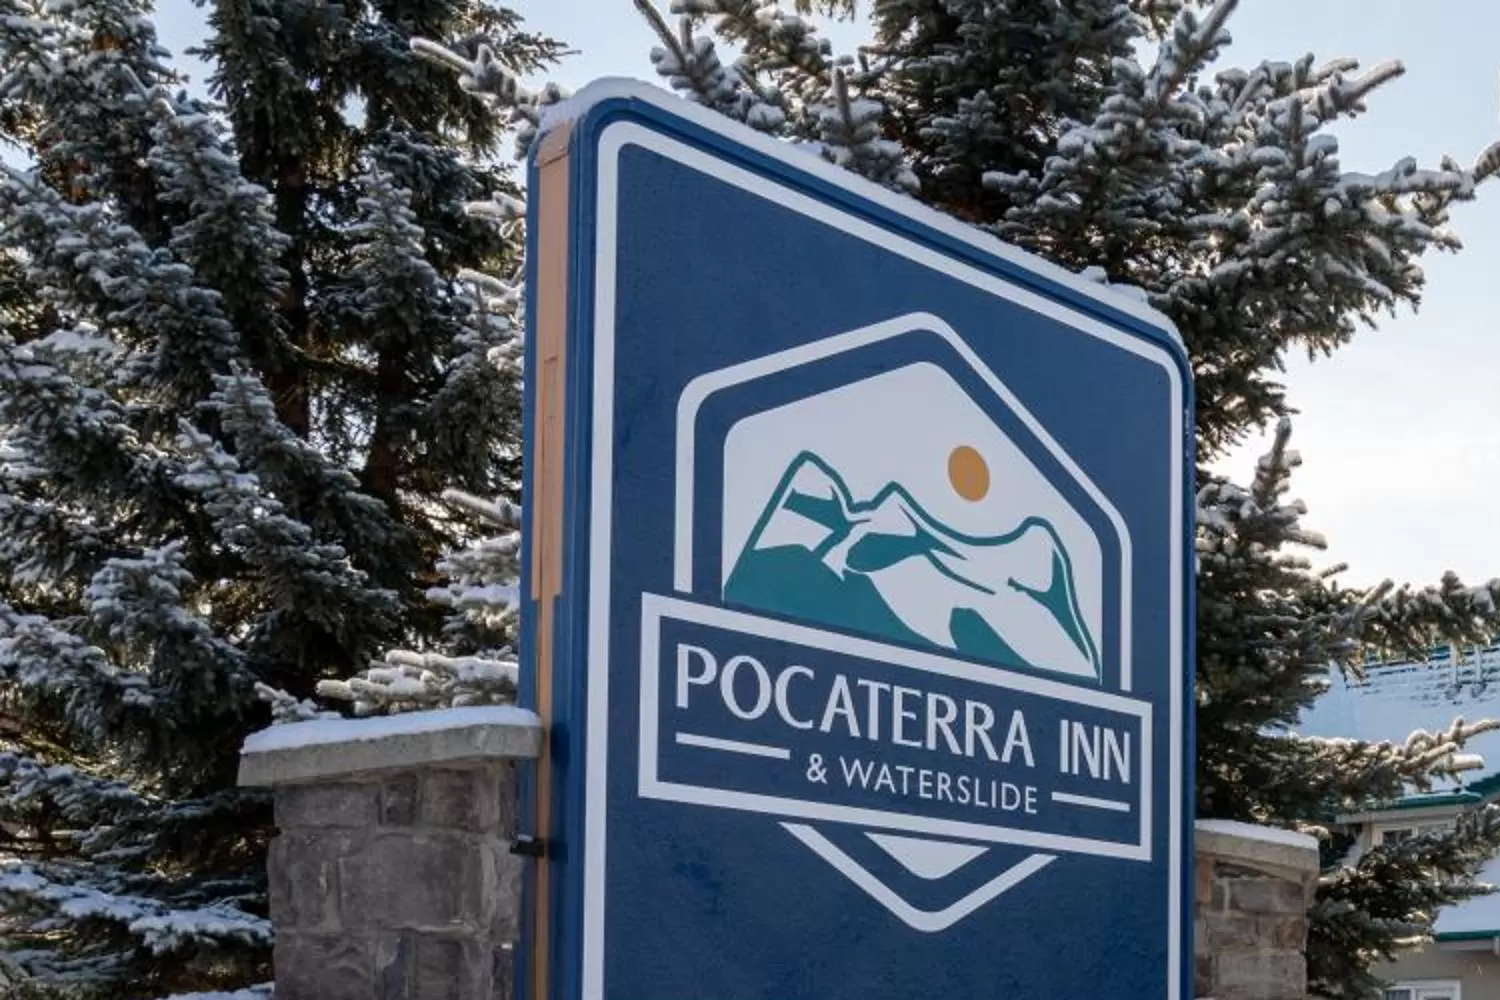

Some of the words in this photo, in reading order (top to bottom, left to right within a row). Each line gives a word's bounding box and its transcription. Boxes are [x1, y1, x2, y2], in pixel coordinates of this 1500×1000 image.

[676, 643, 1035, 768] POCATERRA
[1060, 719, 1131, 784] INN
[806, 753, 827, 784] &
[840, 756, 1037, 814] WATERSLIDE
